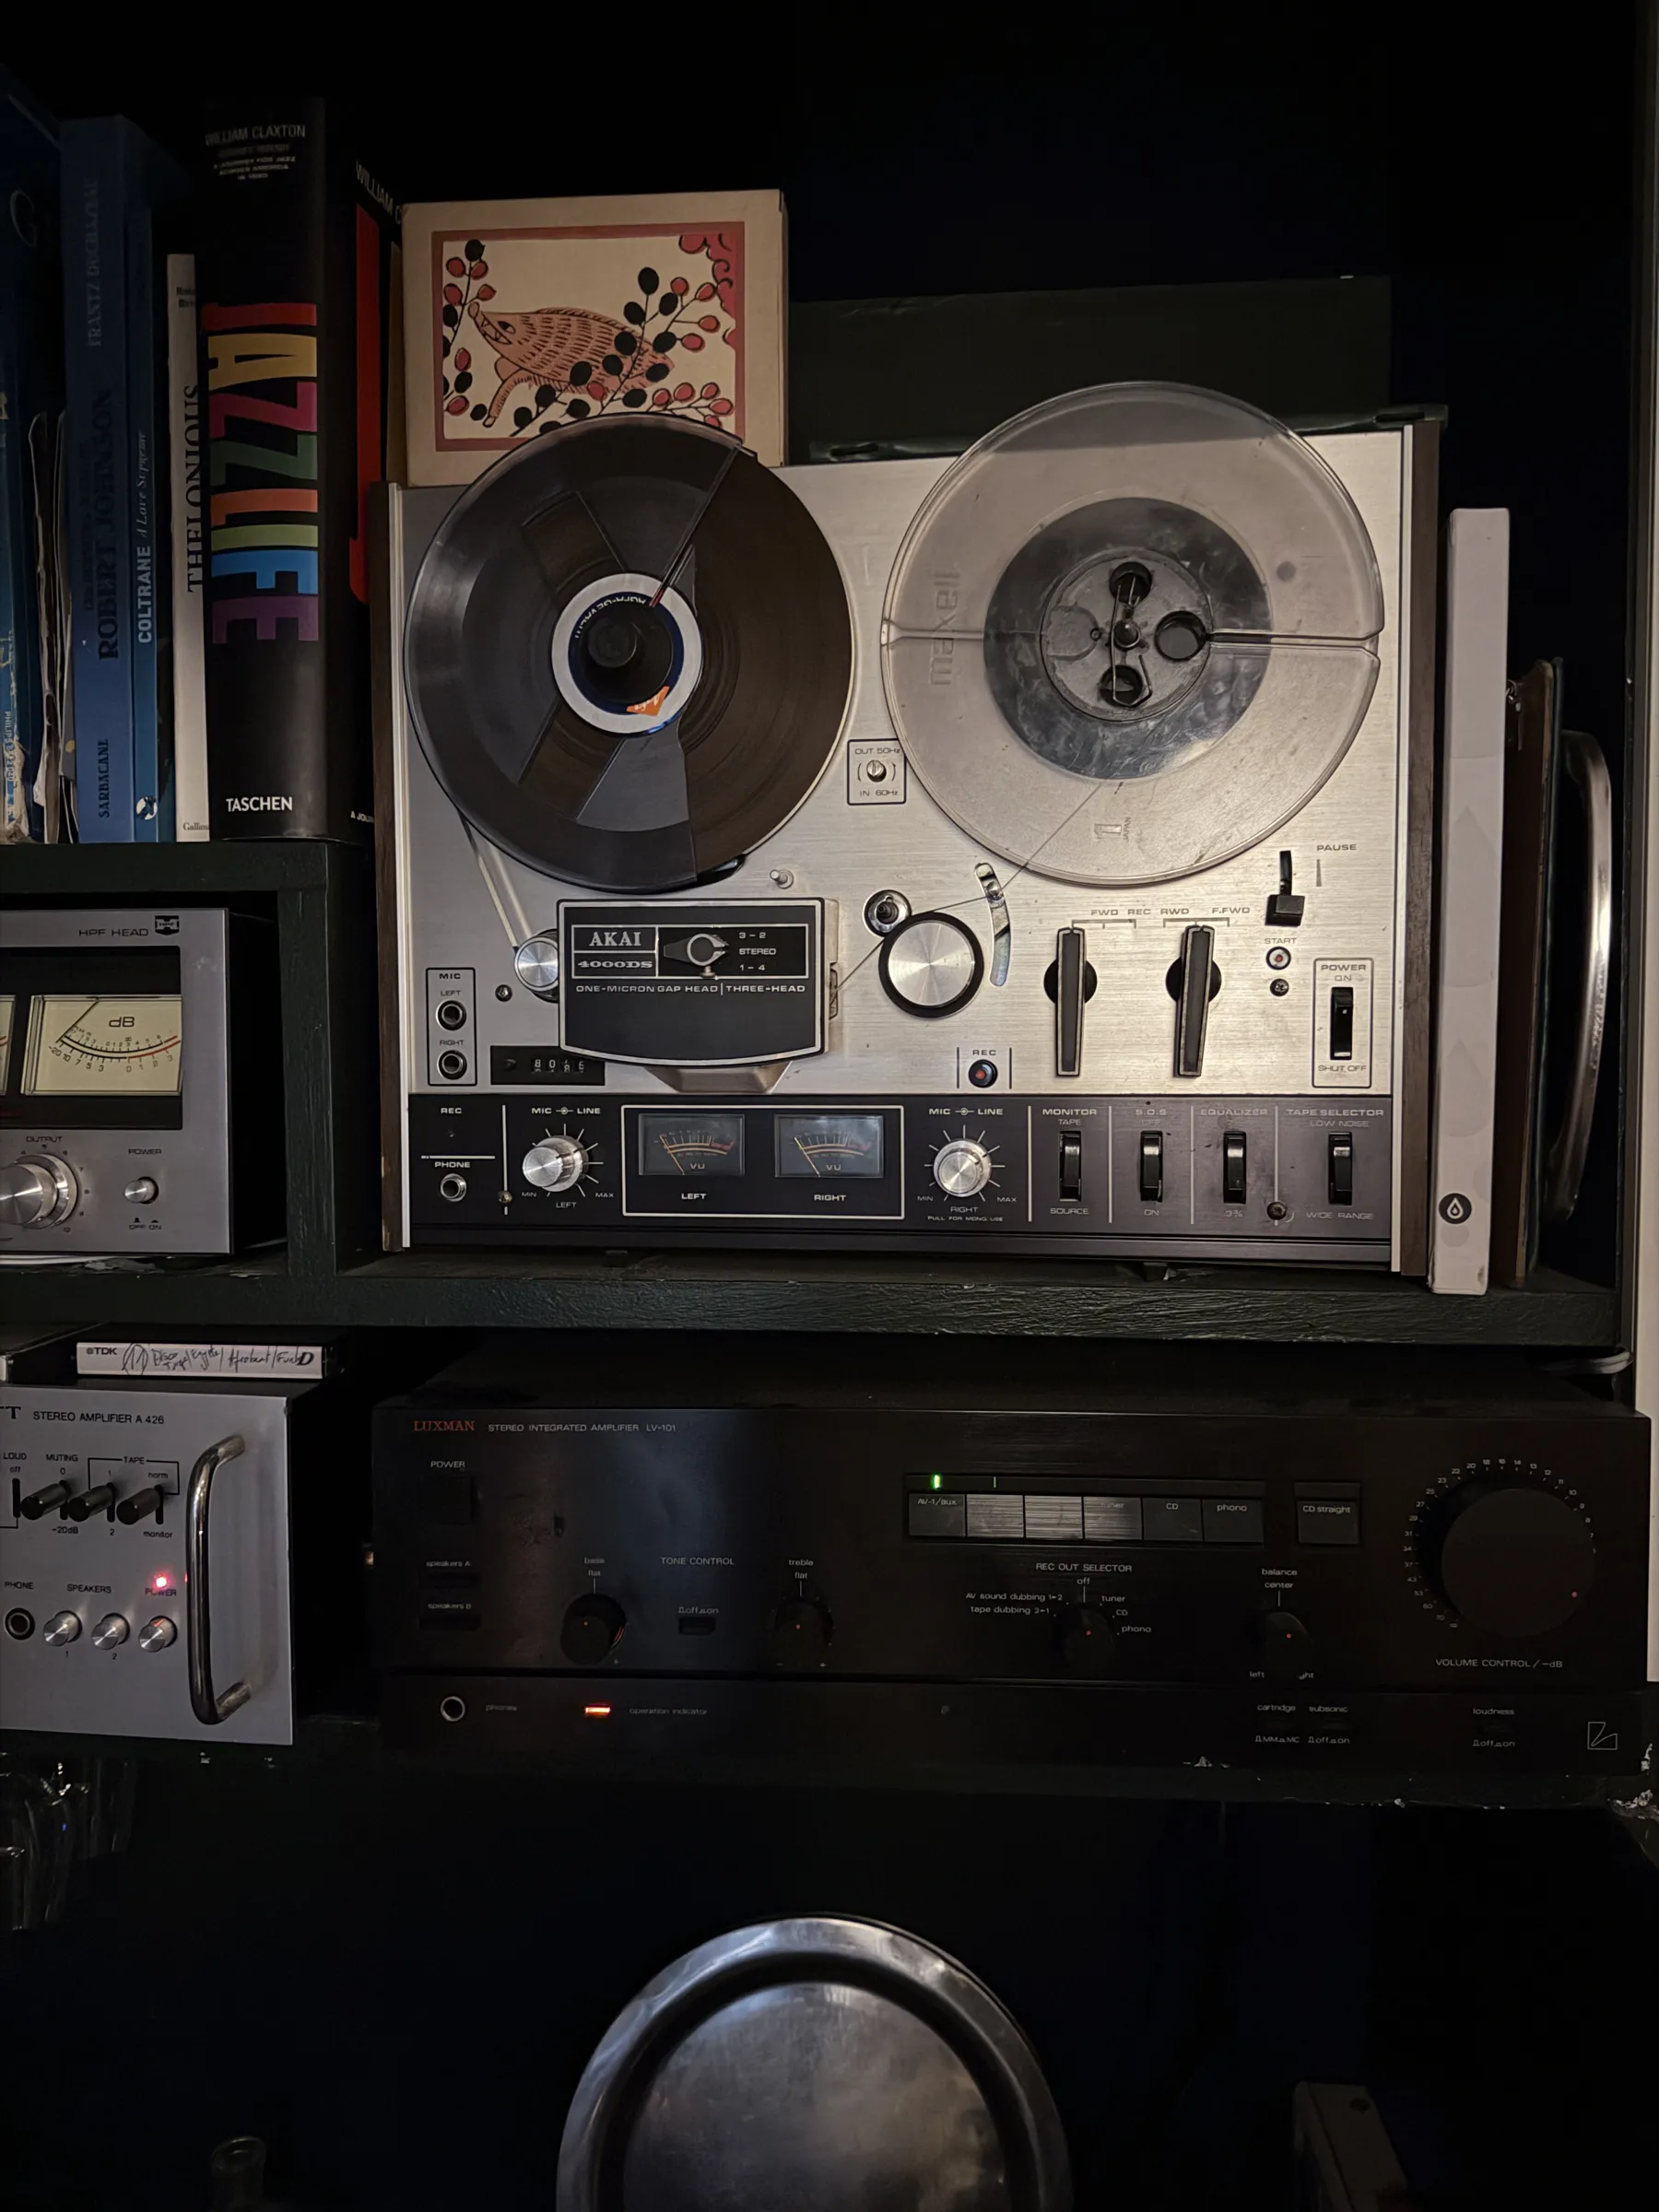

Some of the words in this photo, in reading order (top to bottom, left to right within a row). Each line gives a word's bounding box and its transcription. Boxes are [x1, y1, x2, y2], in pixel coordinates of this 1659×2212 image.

[205, 127, 248, 147] WILLIAM
[252, 124, 307, 140] CLAXTON
[355, 159, 394, 218] WILLIAM
[92, 388, 115, 533] JOHNSON
[135, 491, 147, 525] Love
[137, 545, 153, 643] COLTRANE
[96, 540, 118, 659] ROBERT
[930, 572, 960, 685] maxell
[877, 747, 900, 755] 50Hz
[98, 738, 110, 818] SARBACANE
[876, 789, 899, 797] 60Hz
[226, 796, 293, 812] TASCHEN
[1124, 817, 1132, 842] JAPAN
[78, 928, 106, 937] HPF
[111, 927, 148, 936] HEAD
[589, 932, 641, 947] AKAI
[738, 947, 777, 956] STEREO
[577, 959, 653, 969] 4000DS
[576, 984, 655, 993] ONE-MICRON
[725, 984, 806, 993] THREE-HEAD
[109, 1016, 135, 1028] dB
[439, 1039, 465, 1047] RIGHT
[1042, 1108, 1097, 1116] MONITOR
[1058, 1118, 1082, 1126] TAPE
[689, 1162, 706, 1171] VU
[814, 1194, 847, 1202] RIGHT
[950, 1206, 979, 1214] RIGHT
[1050, 1207, 1089, 1216] SOURCE
[1306, 1211, 1333, 1219] WIDE
[94, 1347, 118, 1356] TDK
[33, 1411, 76, 1422] STEREO
[79, 1413, 133, 1424] AMPLIFIER
[135, 1415, 143, 1424] A
[145, 1415, 165, 1425] 426
[413, 1420, 476, 1432] LUXMAN
[488, 1423, 524, 1432] STEREO
[528, 1423, 587, 1432] INTEGRATED
[590, 1423, 640, 1432] AMPLIFIER
[646, 1423, 677, 1432] LV-101
[3, 1452, 27, 1460] LOUD
[45, 1453, 78, 1463] MUTING
[124, 1456, 145, 1465] TAPE
[429, 1460, 465, 1469] POWER
[1165, 1502, 1179, 1511] CD
[1217, 1503, 1248, 1512] phono
[1302, 1504, 1315, 1512] CD
[1316, 1504, 1352, 1514] straight
[52, 1526, 79, 1535] -20dB
[109, 1528, 115, 1536] 2
[143, 1530, 173, 1539] monitor
[660, 1557, 688, 1565] TONE
[688, 1557, 735, 1566] CONTROL
[789, 1559, 814, 1567] treble
[1036, 1562, 1055, 1571] REC
[1058, 1563, 1079, 1572] OUT
[1083, 1563, 1133, 1573] SELECTOR
[1261, 1568, 1299, 1576] balance
[794, 1571, 808, 1580] flat
[1077, 1577, 1091, 1585] off
[5, 1581, 34, 1590] PHONE
[66, 1583, 112, 1594] SPEAKERS
[145, 1588, 177, 1597] POWER
[965, 1592, 977, 1600] AV
[979, 1593, 1007, 1601] sound
[1009, 1593, 1046, 1603] dubbing
[1101, 1594, 1126, 1603] tuner
[686, 1606, 699, 1615] off
[971, 1606, 991, 1616] tape
[993, 1606, 1030, 1617] dubbing
[1115, 1608, 1128, 1617] CD
[1121, 1624, 1152, 1634] phono
[1435, 1658, 1478, 1667] VOLUME
[1249, 1670, 1265, 1678] left
[629, 1707, 670, 1715] operation
[672, 1707, 708, 1715] indicator
[1256, 1704, 1297, 1713] cartridge
[1308, 1705, 1348, 1713] subsonic
[1472, 1707, 1515, 1716] loudness
[1479, 1739, 1494, 1747] off
